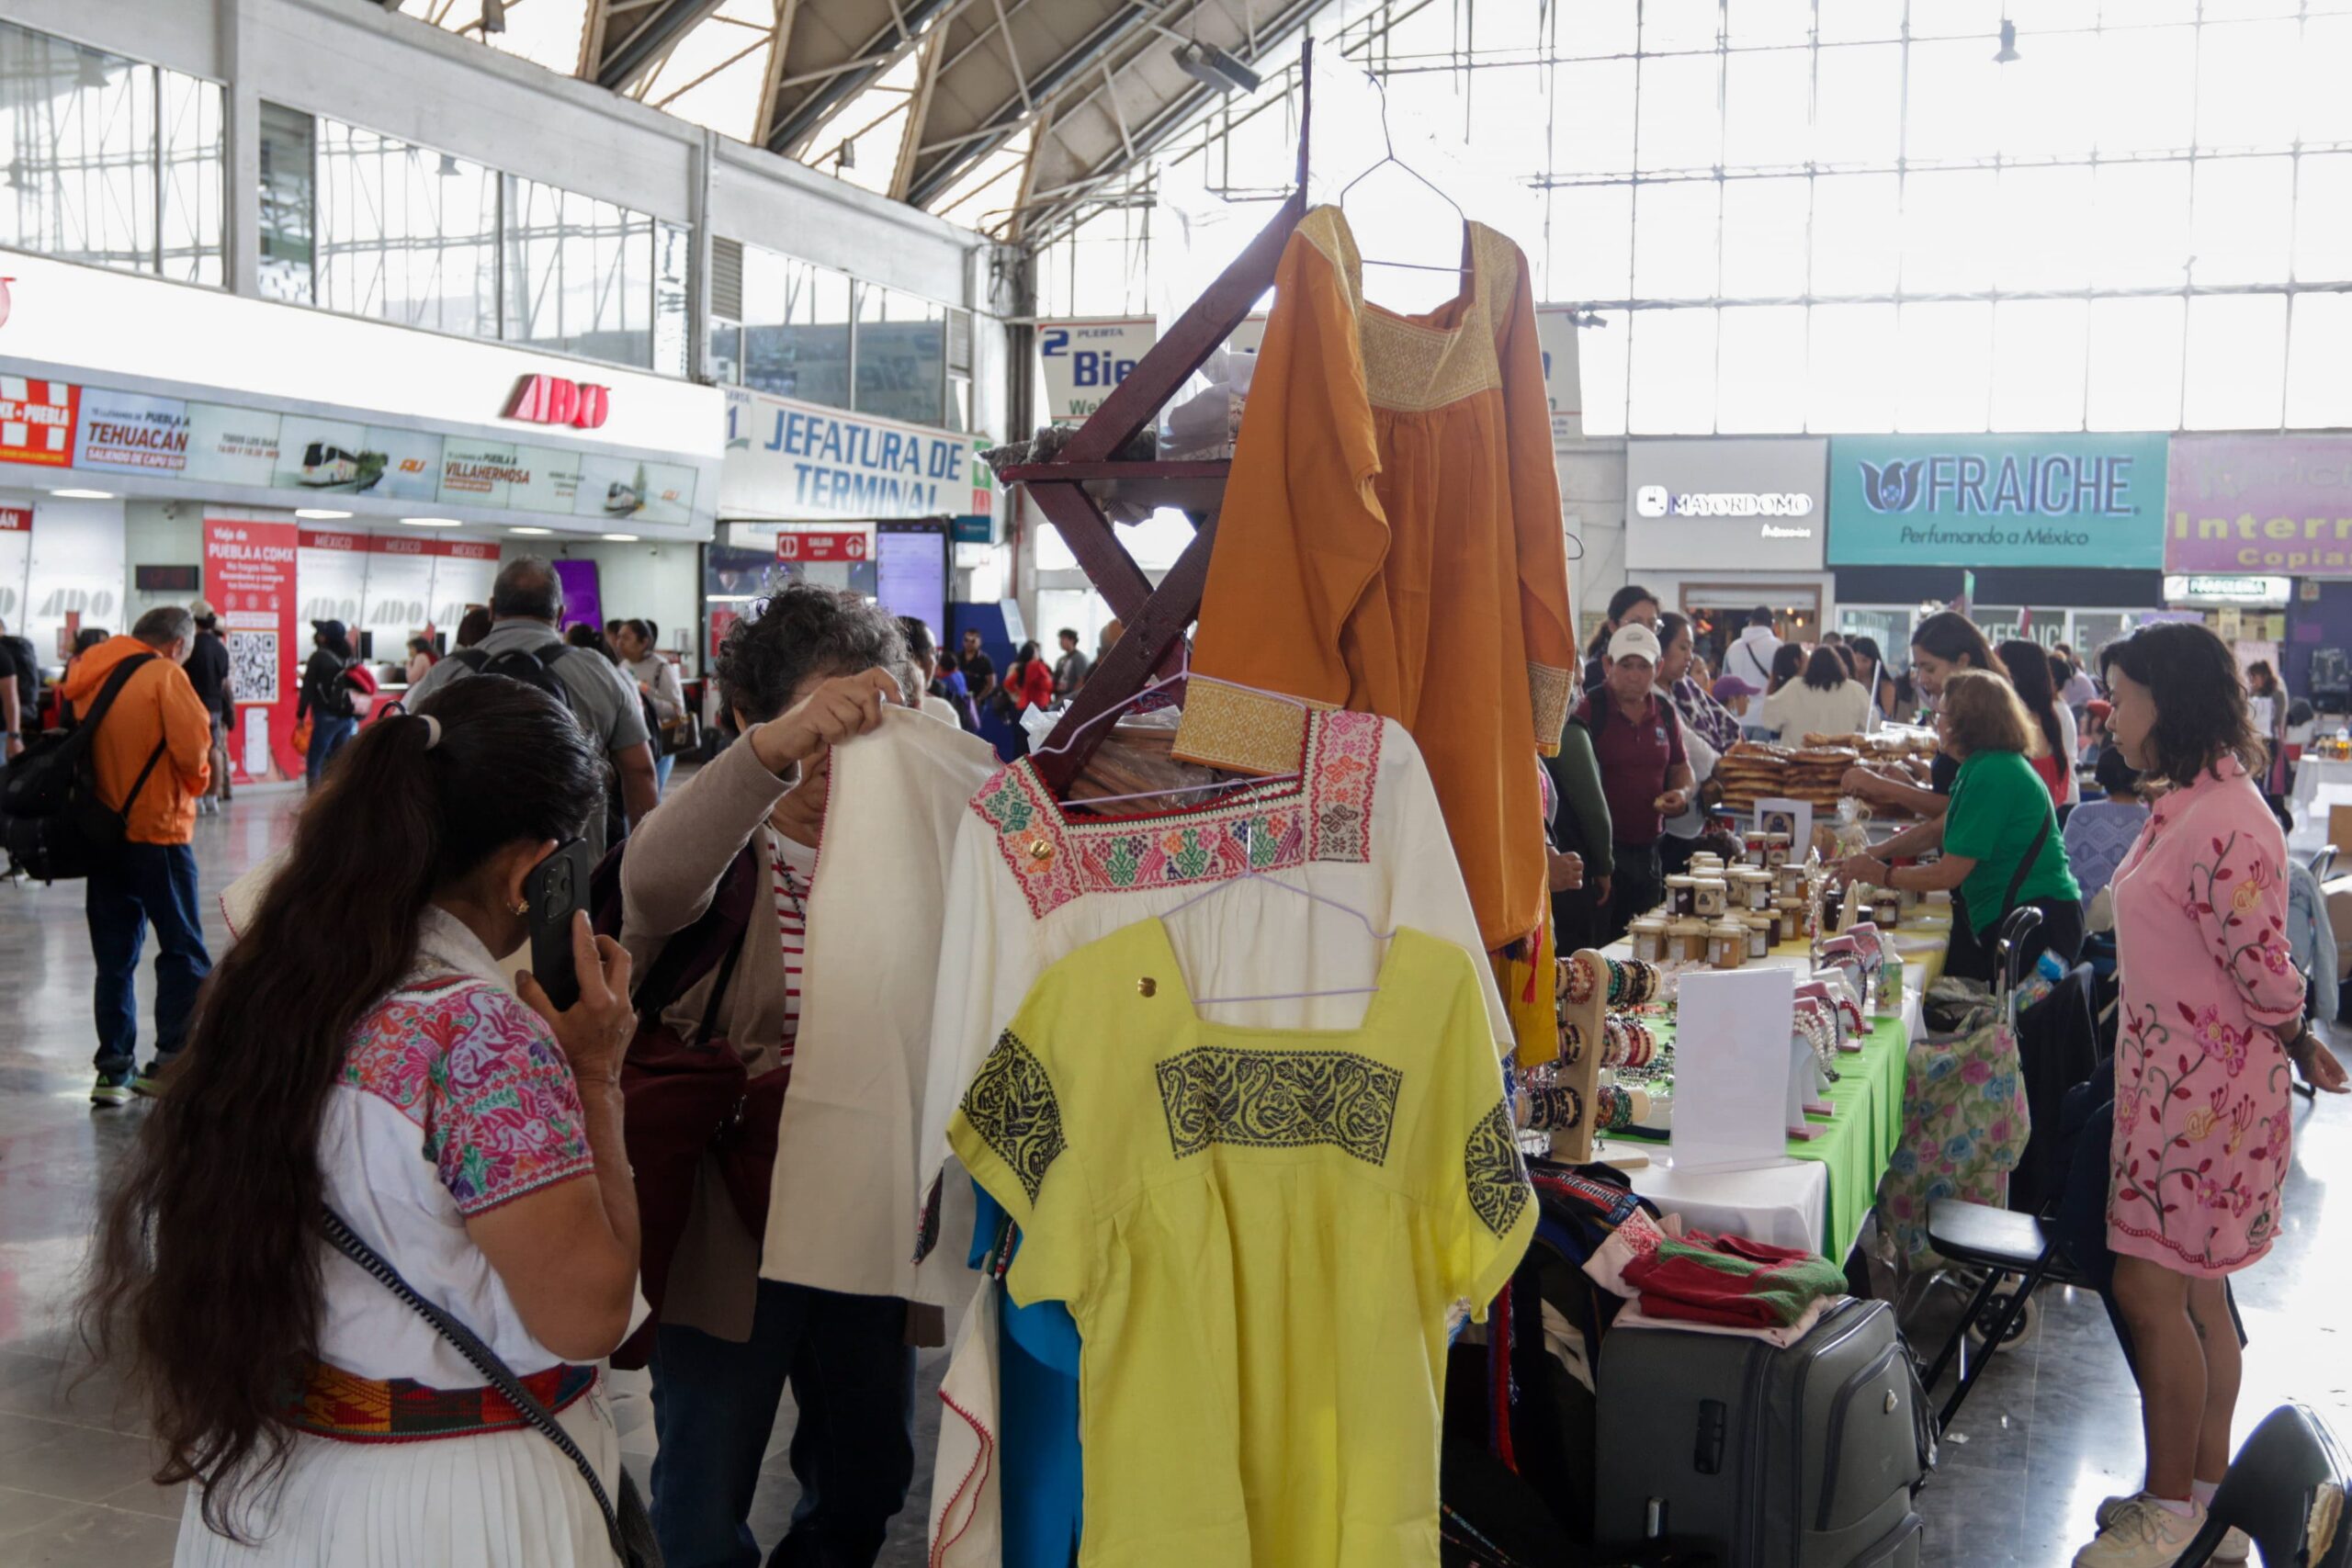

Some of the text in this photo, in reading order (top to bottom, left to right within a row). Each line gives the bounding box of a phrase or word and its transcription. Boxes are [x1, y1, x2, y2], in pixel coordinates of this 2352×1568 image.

[1043, 329, 1069, 356] 2
[1077, 328, 1125, 338] PUERTA
[502, 373, 608, 428] ADO
[23, 403, 69, 426] PUEBLA
[144, 411, 181, 426] PUEBLA
[183, 417, 190, 426] A
[728, 405, 738, 439] 1
[88, 421, 189, 452] TEHUACÁN
[764, 409, 964, 480] JEFATURA DE
[446, 461, 530, 484] VILLAHERMOSA
[1928, 455, 2134, 514] FRAICHE
[794, 462, 938, 514] TERMINAL
[1668, 493, 1813, 516] MAYORDOMO
[314, 534, 353, 550] MÉXICO
[386, 538, 422, 554] MÉXICO
[1900, 524, 2089, 546] Perfumando a México
[209, 543, 294, 562] PUEBLA A CDMX
[451, 543, 485, 558] MÉXICO
[38, 589, 114, 617] ADO
[300, 597, 356, 624] ADO
[369, 600, 424, 625] ADO
